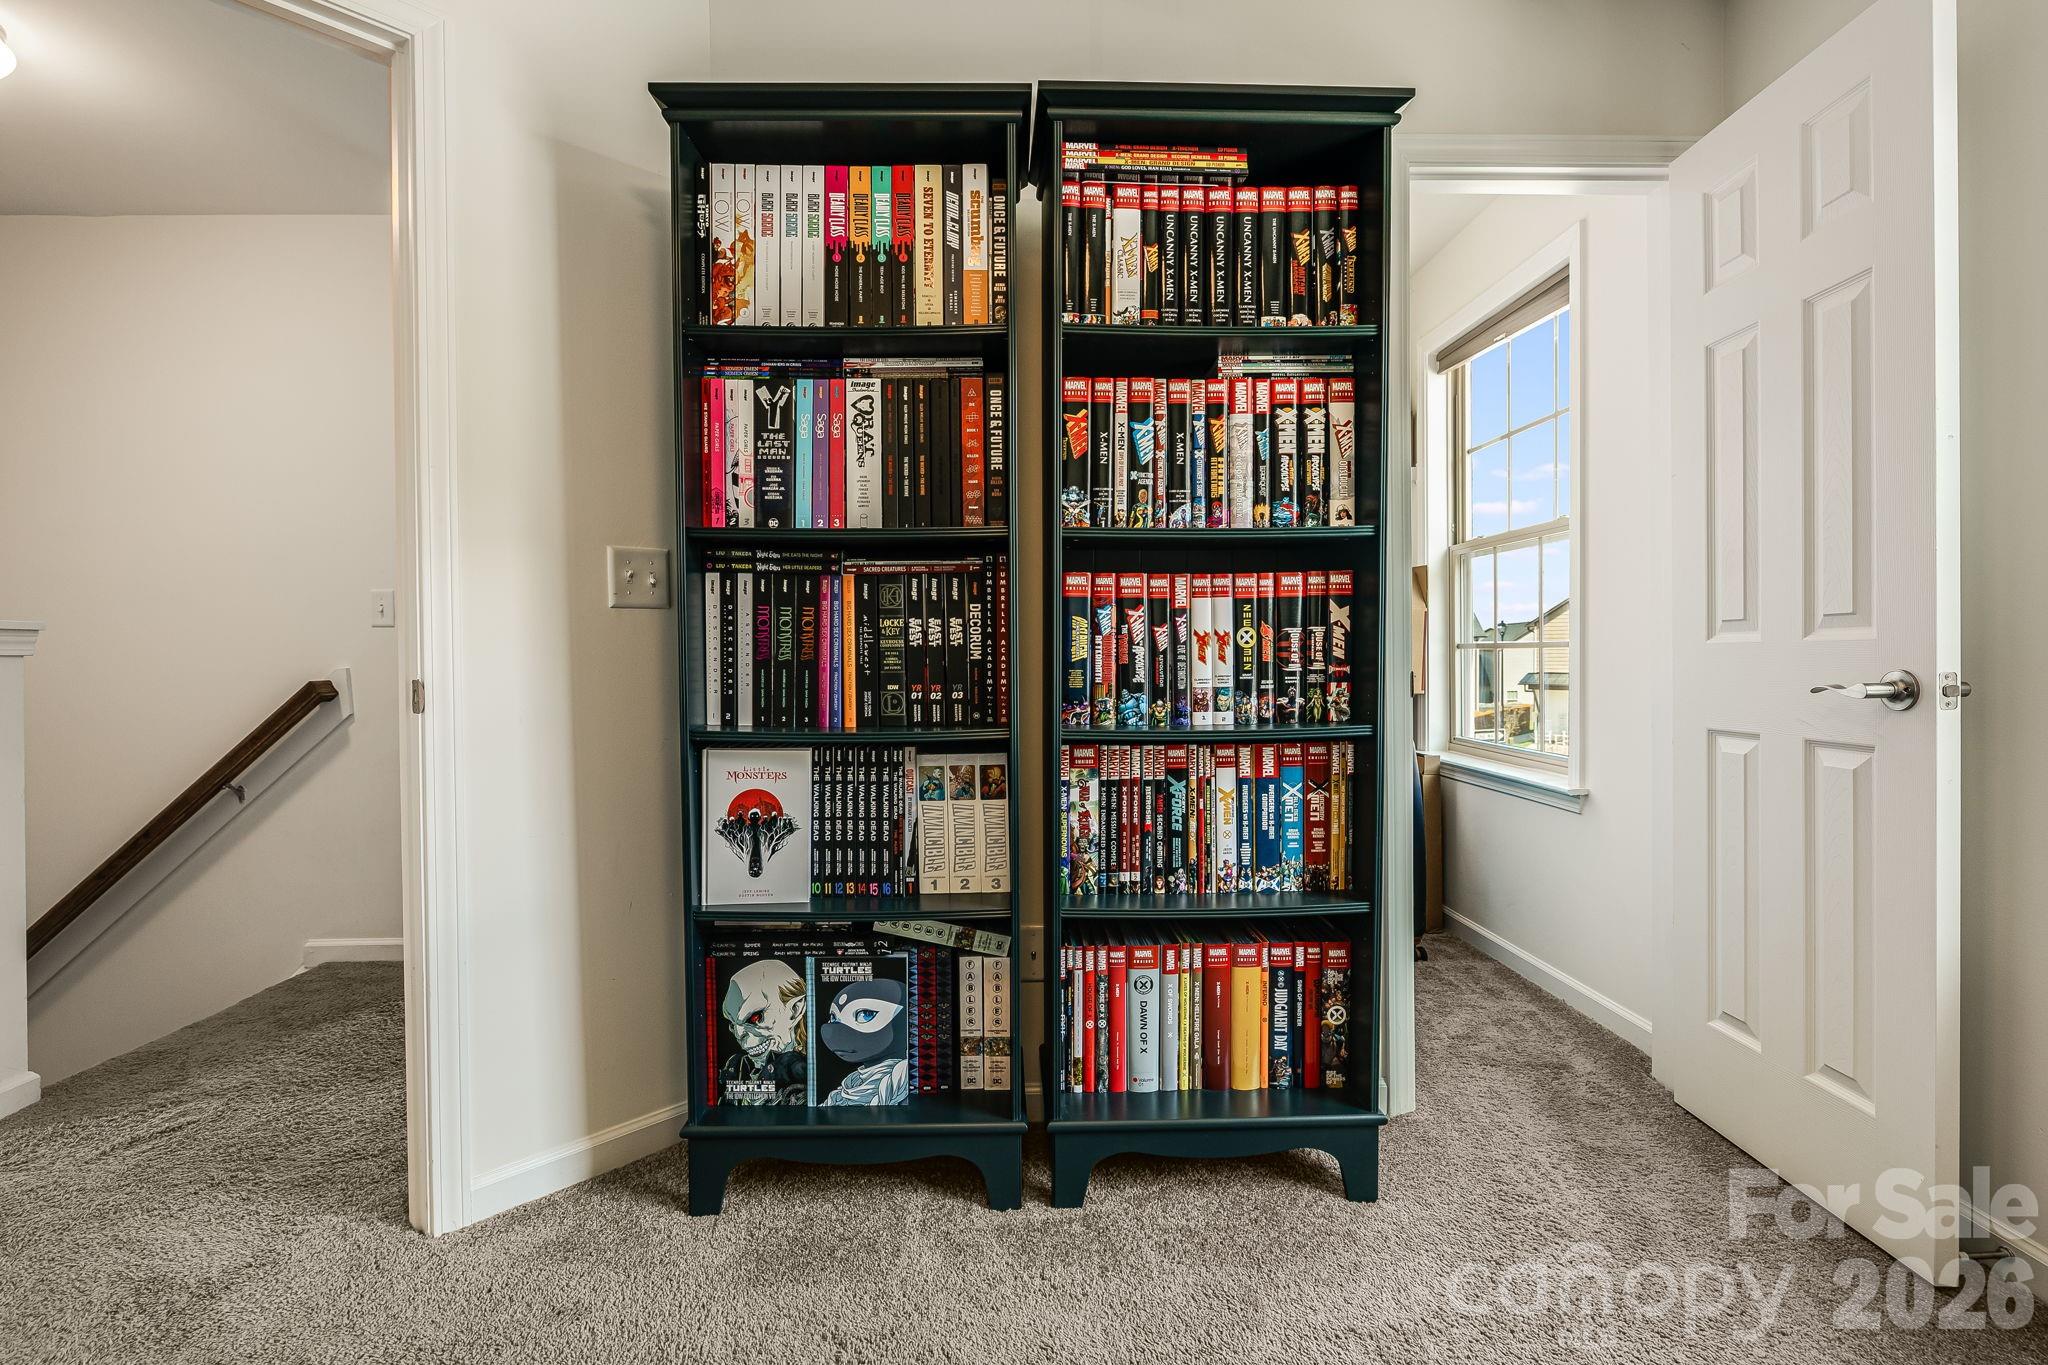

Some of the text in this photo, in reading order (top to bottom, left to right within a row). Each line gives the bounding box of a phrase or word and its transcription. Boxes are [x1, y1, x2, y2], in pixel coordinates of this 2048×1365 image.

[714, 191, 730, 233] LOW
[736, 191, 751, 230] LOW
[761, 192, 774, 238] BLACK SCIENCE
[785, 193, 798, 238] BLACK SCIENCE
[807, 193, 820, 238] BLACK SCIENCE
[828, 192, 845, 237] DEADLY CLASS
[853, 193, 869, 237] DEADLY CLASS
[874, 193, 890, 237] DEADLY CLASS
[895, 193, 911, 237] DEADLY CLASS
[923, 186, 934, 220] SEVEN
[923, 223, 934, 235] TO
[945, 190, 959, 250] DEATH GLORY
[993, 195, 1006, 277] ONCE & FUTURE
[1120, 232, 1138, 279] X-MEN
[1293, 230, 1311, 267] X-MEN
[1319, 227, 1335, 260] X-MEN
[1342, 226, 1357, 253] X-MEN
[1143, 242, 1159, 273] X-MEN
[1189, 215, 1198, 302] UNCANNY X-MEN
[1216, 216, 1225, 303] UNCANNY X-MEN
[1243, 216, 1252, 303] UNCANNY X-MEN
[1234, 382, 1247, 414] MARVEL
[1255, 382, 1268, 414] MARVEL
[799, 413, 810, 439] Saga
[815, 413, 827, 439] Saga
[831, 413, 842, 438] Saga
[850, 413, 866, 468] QUEENS
[864, 416, 875, 457] RAT
[990, 389, 1003, 471] ONCE & FUTURE
[1063, 409, 1089, 460] X-MEN
[1117, 422, 1125, 451] X-MEN
[1129, 416, 1155, 466] X-MEN
[1208, 414, 1226, 454] X-MEN
[1234, 422, 1248, 451] X-MEN
[1275, 407, 1297, 454] X-MEN
[1303, 407, 1326, 454] X-MEN
[1332, 419, 1353, 460] X-MEN
[1176, 432, 1184, 465] X-MEN
[1281, 455, 1289, 492] APOCALYPSE
[1312, 455, 1320, 491] APOCALYPSE
[767, 518, 779, 529] DC
[1174, 577, 1187, 608] MARVEL
[756, 605, 770, 661] MONSTRESS
[778, 607, 792, 661] MONSTRESS
[800, 607, 815, 661] MONSTRESS
[879, 618, 905, 627] LOCKE
[969, 603, 982, 660] DECORUM
[1097, 605, 1112, 636] X-MEN
[1174, 614, 1188, 643] X-MEN
[1329, 598, 1351, 660] X-MEN
[1125, 605, 1145, 683] X-MEN APOCALYPSE
[1152, 624, 1168, 652] X-MEN
[1177, 645, 1186, 654] EVE
[1240, 604, 1254, 671] NEW X MEN
[911, 683, 922, 692] YR
[930, 683, 941, 692] YR
[1177, 662, 1186, 690] DESTRUCTION
[951, 691, 964, 700] 03
[1073, 749, 1095, 757] MARVEL
[1131, 749, 1141, 779] MARVEL
[1144, 749, 1153, 779] MARVEL
[1239, 747, 1251, 778] MARVEL
[1262, 747, 1274, 778] MARVEL
[726, 771, 788, 784] MONSTERS
[921, 804, 946, 874] INVINCIBLE
[951, 803, 977, 873] INVINCIBLE
[982, 803, 1008, 873] INVINCIBLE
[811, 882, 821, 894] 10
[835, 882, 843, 894] 12
[846, 882, 855, 894] 13
[869, 882, 879, 894] 15
[882, 882, 891, 894] 16
[959, 879, 970, 890] 2
[991, 878, 1001, 889] 3
[1166, 949, 1175, 971] MARVEL
[1193, 948, 1202, 969] MARVEL
[1296, 946, 1305, 968] MARVEL
[992, 960, 1002, 1027] FABLES
[1139, 1000, 1148, 1029] DAWN
[1274, 988, 1288, 1051] JUDGMENT DAY
[1139, 1032, 1148, 1045] OF
[725, 1084, 776, 1092] TURTLES
